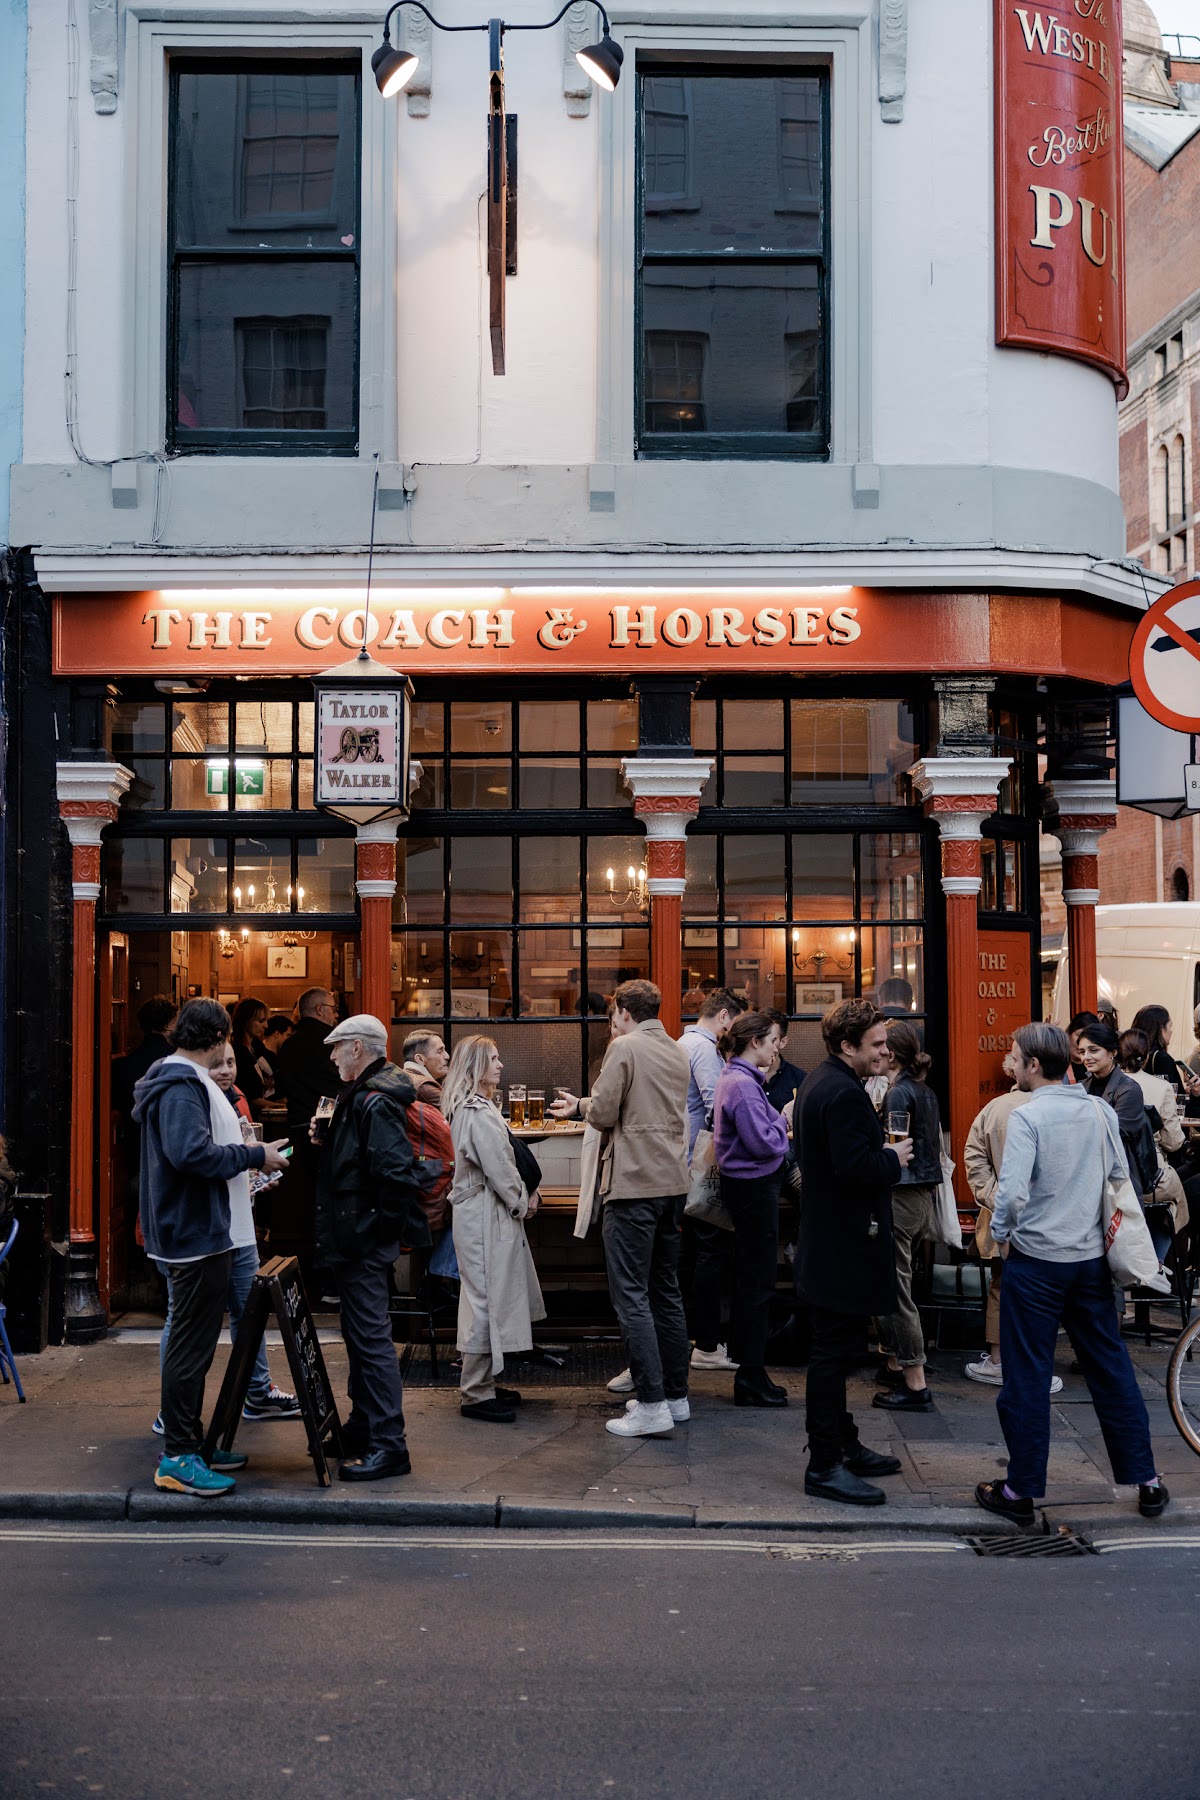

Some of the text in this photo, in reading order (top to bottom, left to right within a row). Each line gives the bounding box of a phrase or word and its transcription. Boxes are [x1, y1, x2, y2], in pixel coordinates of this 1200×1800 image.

[1028, 124, 1090, 166] Best
[143, 605, 862, 650] THE COACH & HORSES
[329, 700, 390, 719] TAYLOR
[326, 769, 391, 788] WALKER
[978, 952, 1007, 971] THE
[978, 981, 1016, 998] OACH
[986, 1007, 998, 1026] &
[978, 1034, 1013, 1052] ORSE
